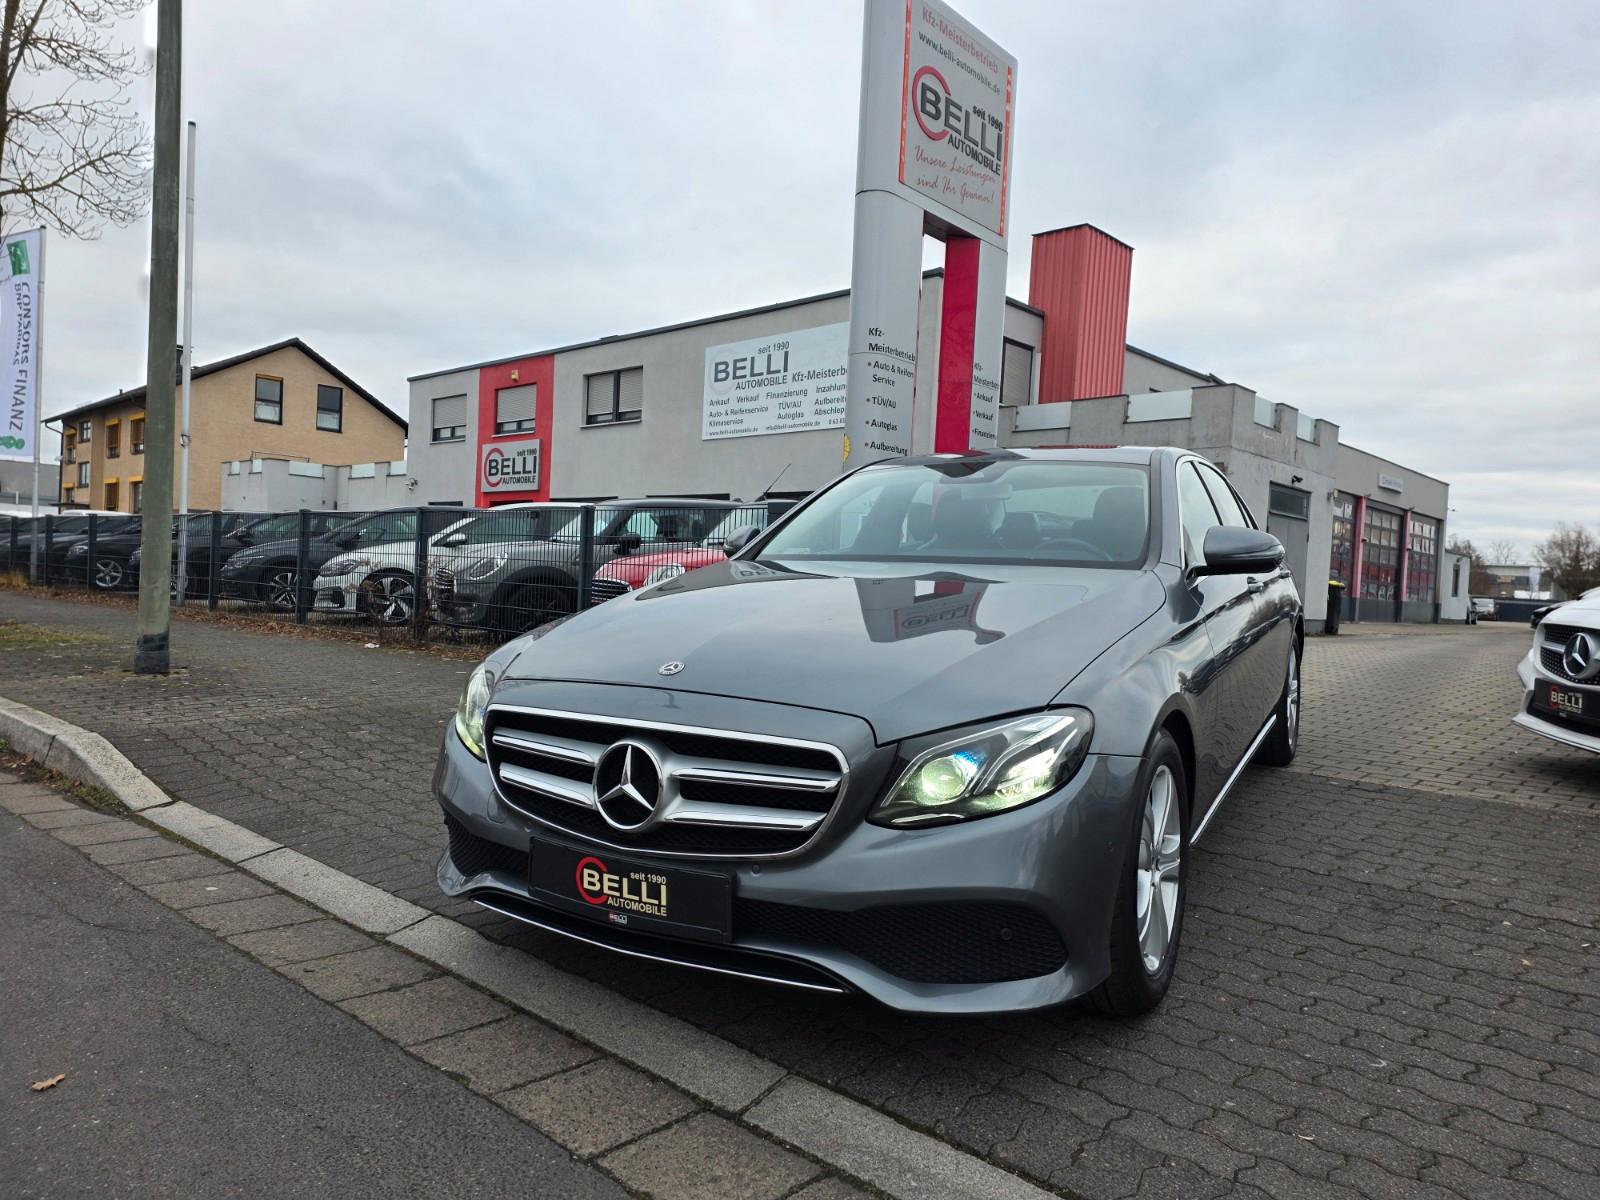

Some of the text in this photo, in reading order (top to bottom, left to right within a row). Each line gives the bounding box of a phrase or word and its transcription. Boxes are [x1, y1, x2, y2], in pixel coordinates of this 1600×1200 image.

[922, 7, 999, 74] Kfz-Meisterbetrieb
[918, 31, 1001, 96] www.belli-automobile.de
[920, 82, 1002, 162] BELLI
[972, 105, 1003, 132] seit 1990
[914, 145, 947, 169] Unsere
[947, 133, 1001, 176] AUTOMOBILE
[917, 174, 939, 189] sind
[868, 328, 885, 337] Kfz-
[757, 341, 790, 354] seit 1990
[868, 342, 915, 362] Meisterbetrieb
[9, 281, 31, 431] CONSORS FINANZ
[713, 350, 789, 383] BELLI
[873, 360, 890, 372] Auto
[890, 364, 896, 373] &
[735, 375, 788, 391] AUTOMOBILE
[872, 374, 896, 387] Service
[766, 388, 808, 400] Finanzierung
[816, 383, 848, 393] Inzahlun
[709, 397, 730, 407] Ankauf
[736, 394, 759, 403] Verkauf
[872, 395, 897, 409] TÜV/AU
[976, 392, 993, 403] Ankauf
[777, 411, 805, 421] Autoglas
[814, 406, 845, 417] Abschlep
[975, 409, 994, 421] Verkauf
[709, 418, 744, 428] Klimaservice
[870, 418, 898, 431] Autoglas
[517, 449, 526, 457] seit
[869, 441, 908, 457] Aufbereitung
[488, 456, 537, 477] BELLI
[502, 475, 536, 485] AUTOMOBILE
[1551, 691, 1583, 709] BELLI
[630, 872, 667, 885] seit 1990
[583, 868, 667, 906] BELLI
[607, 896, 668, 917] AUTOMOBILE
